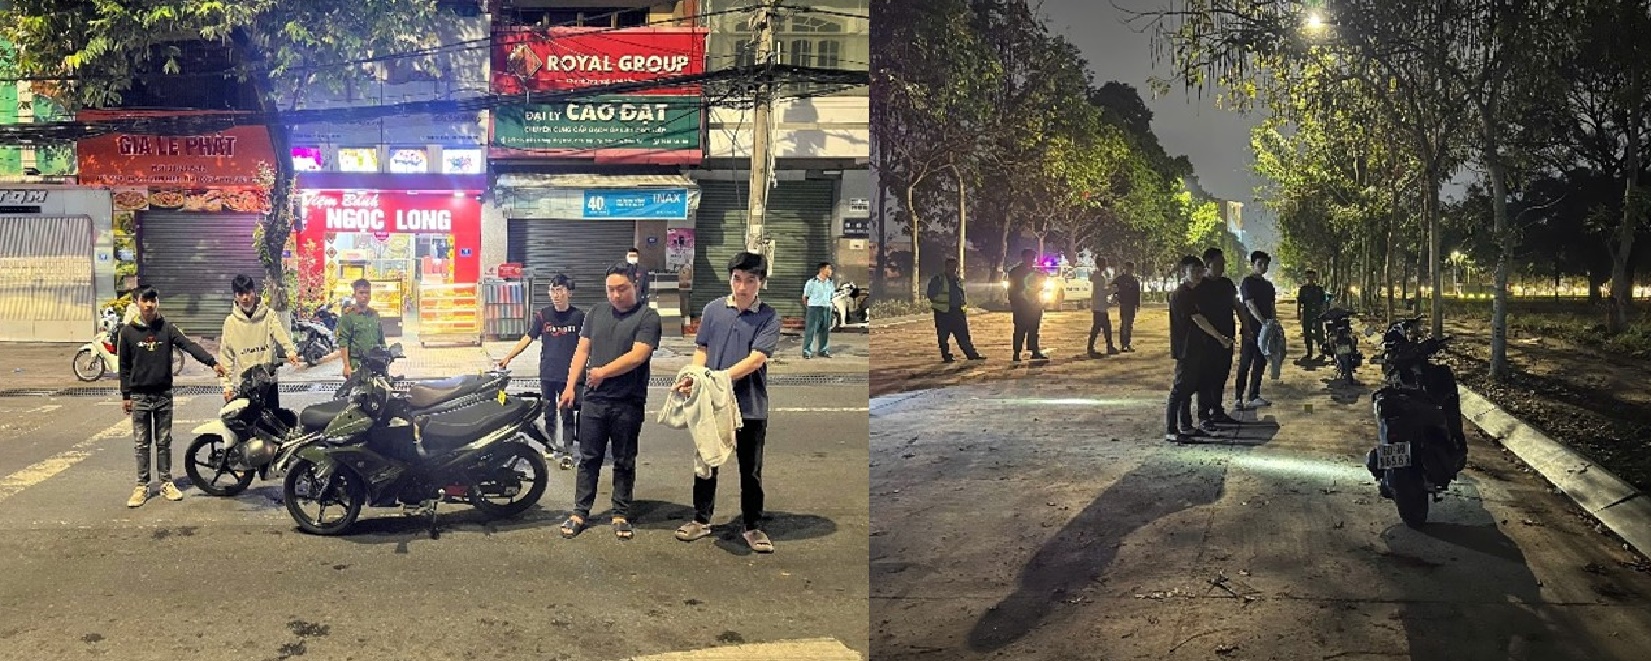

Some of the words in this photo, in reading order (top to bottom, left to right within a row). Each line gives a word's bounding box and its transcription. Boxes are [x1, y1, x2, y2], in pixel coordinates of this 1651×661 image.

[547, 55, 612, 71] ROYAL
[619, 55, 689, 71] GROUP
[566, 103, 615, 121] CAO
[619, 103, 668, 125] ĐẠT
[118, 134, 152, 156] GIA
[587, 195, 604, 211] 40
[653, 193, 681, 204] INAX
[326, 209, 385, 233] NGỌC
[397, 209, 452, 231] LONG
